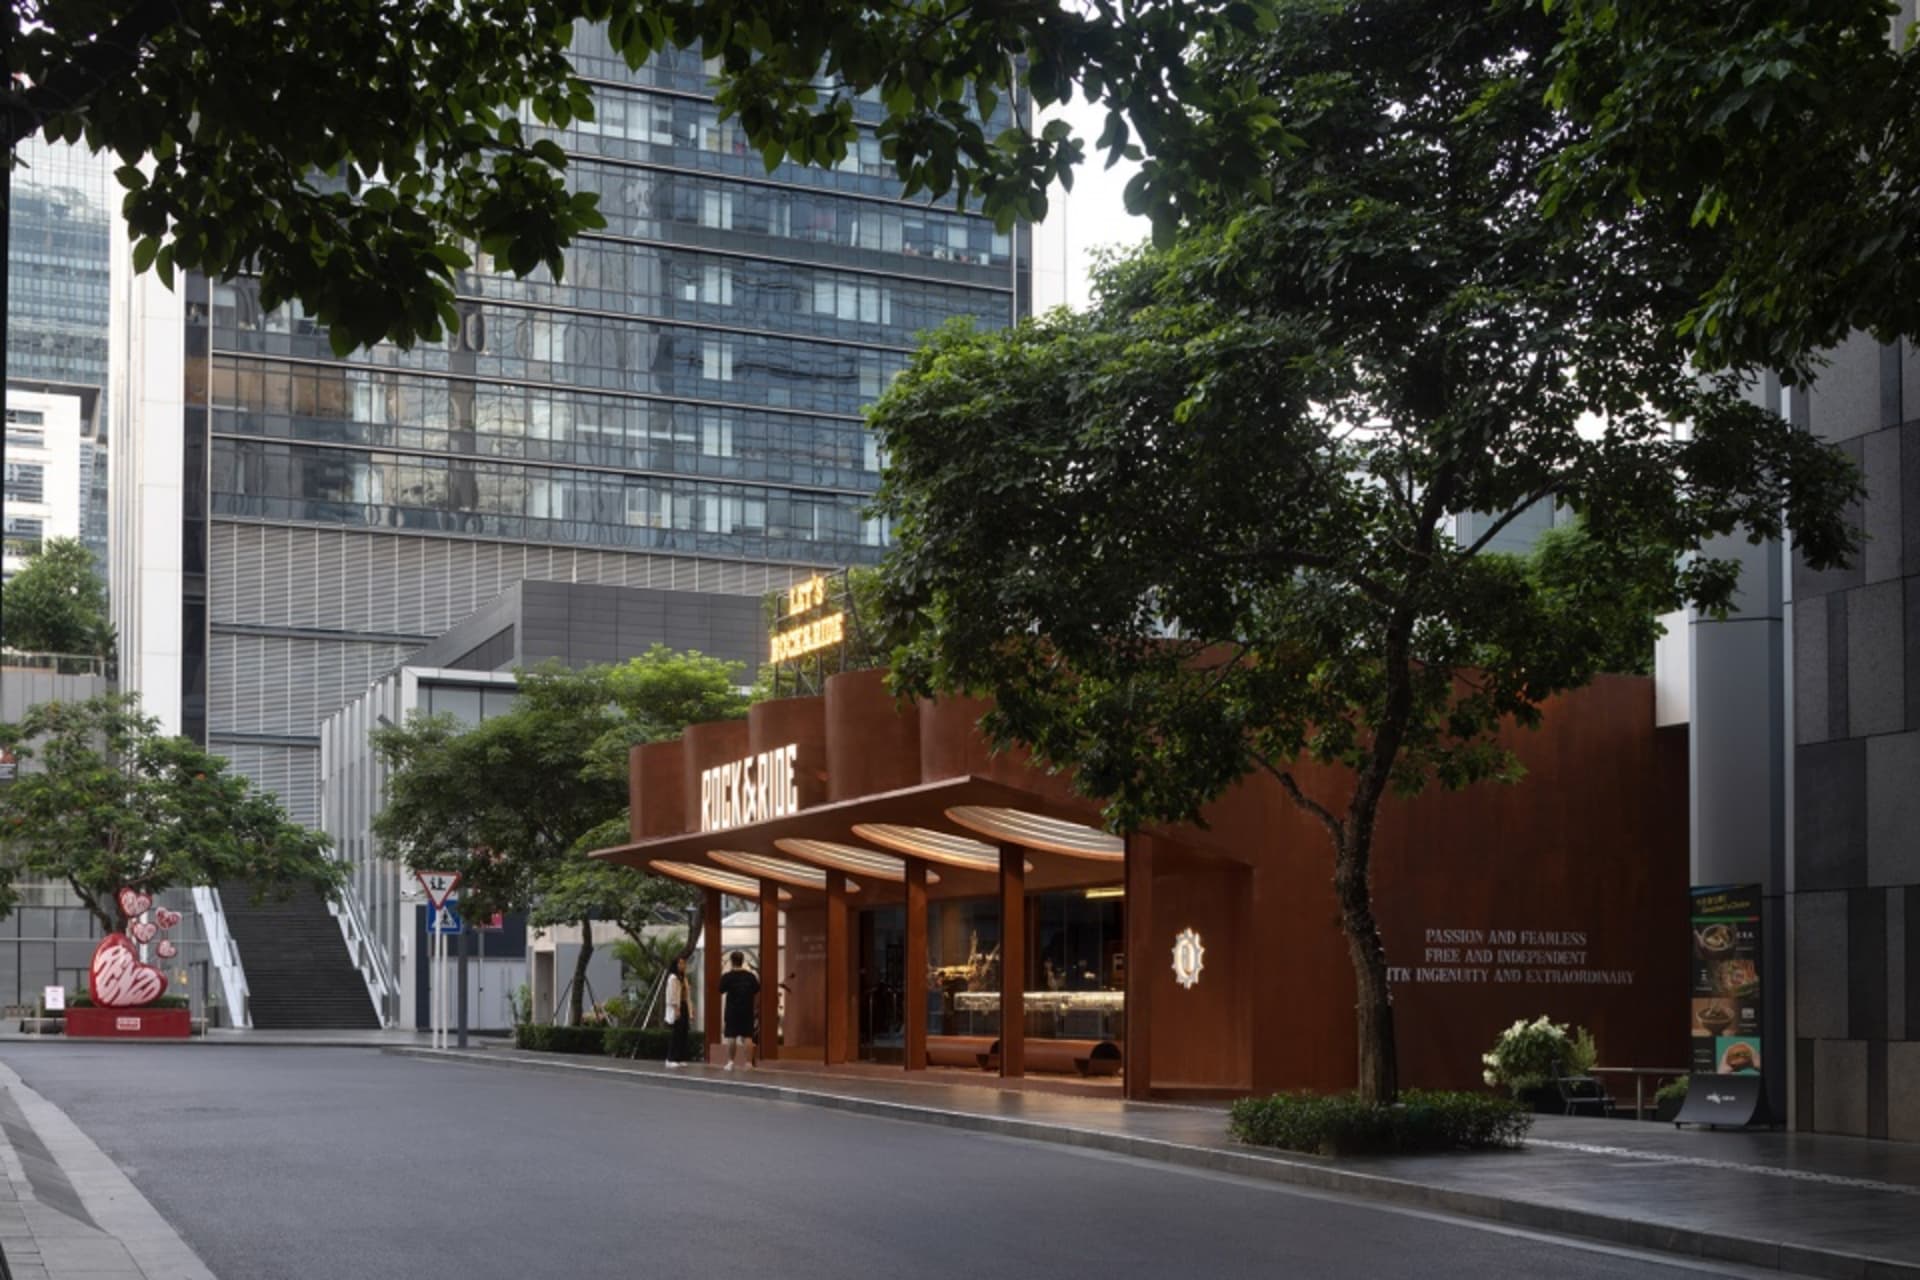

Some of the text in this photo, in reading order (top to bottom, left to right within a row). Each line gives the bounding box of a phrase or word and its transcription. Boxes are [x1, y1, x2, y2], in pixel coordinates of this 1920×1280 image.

[789, 574, 824, 615] LET'S
[701, 743, 798, 833] ROCK&RIDE
[430, 876, 446, 890] 让
[1425, 928, 1588, 947] PASSION AND FEARLESS
[1424, 947, 1588, 965] FREE AND INDEPENDENT
[1416, 967, 1489, 983] INGENUITY
[1494, 968, 1522, 984] AND
[1525, 969, 1635, 985] EXTRAORDINARY
